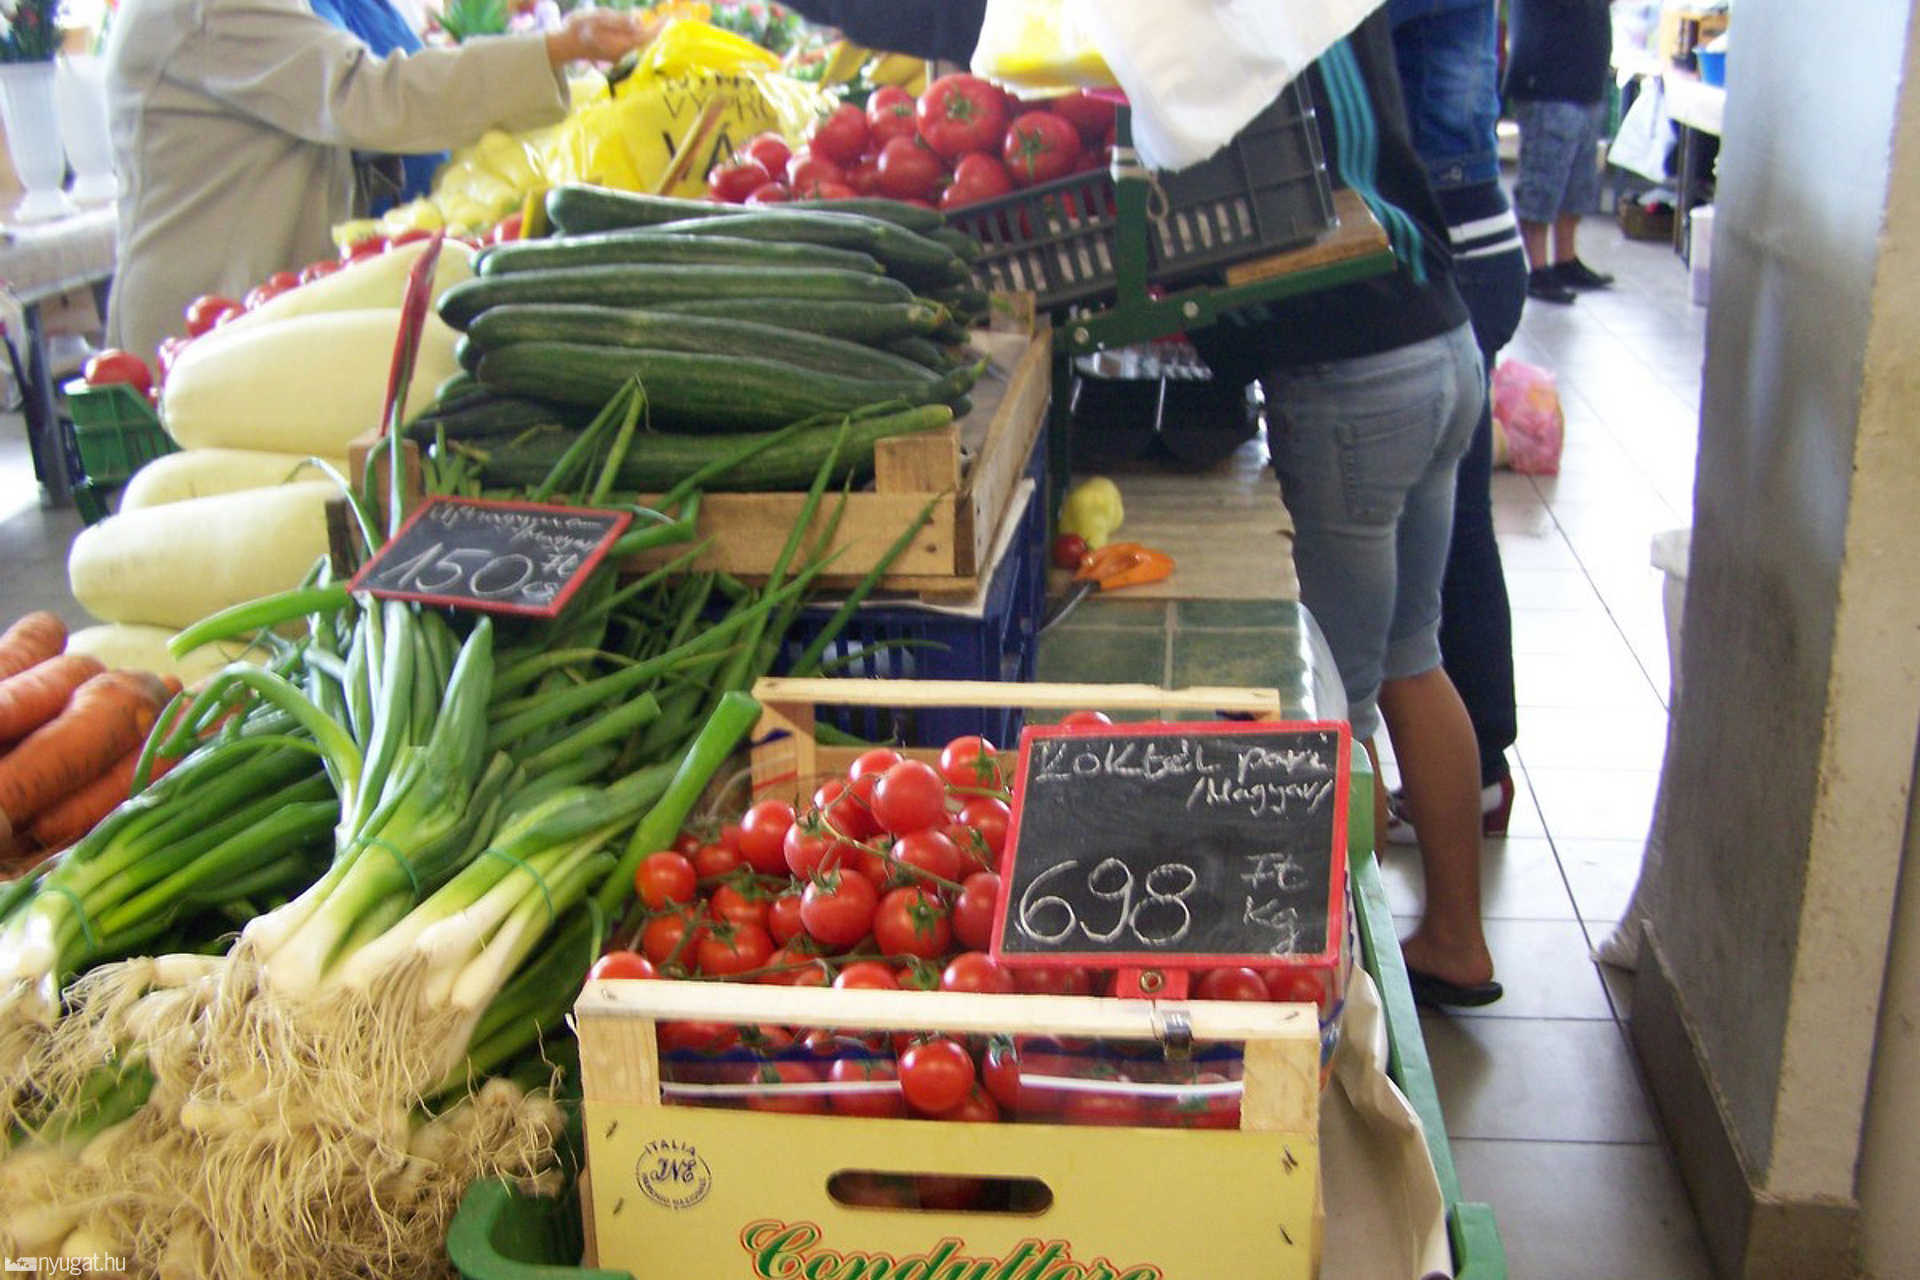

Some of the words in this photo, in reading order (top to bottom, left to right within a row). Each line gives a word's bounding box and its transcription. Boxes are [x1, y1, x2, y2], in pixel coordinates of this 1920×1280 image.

[378, 541, 534, 598] 150
[1014, 856, 1198, 946] 698
[644, 1139, 697, 1157] ITALIA
